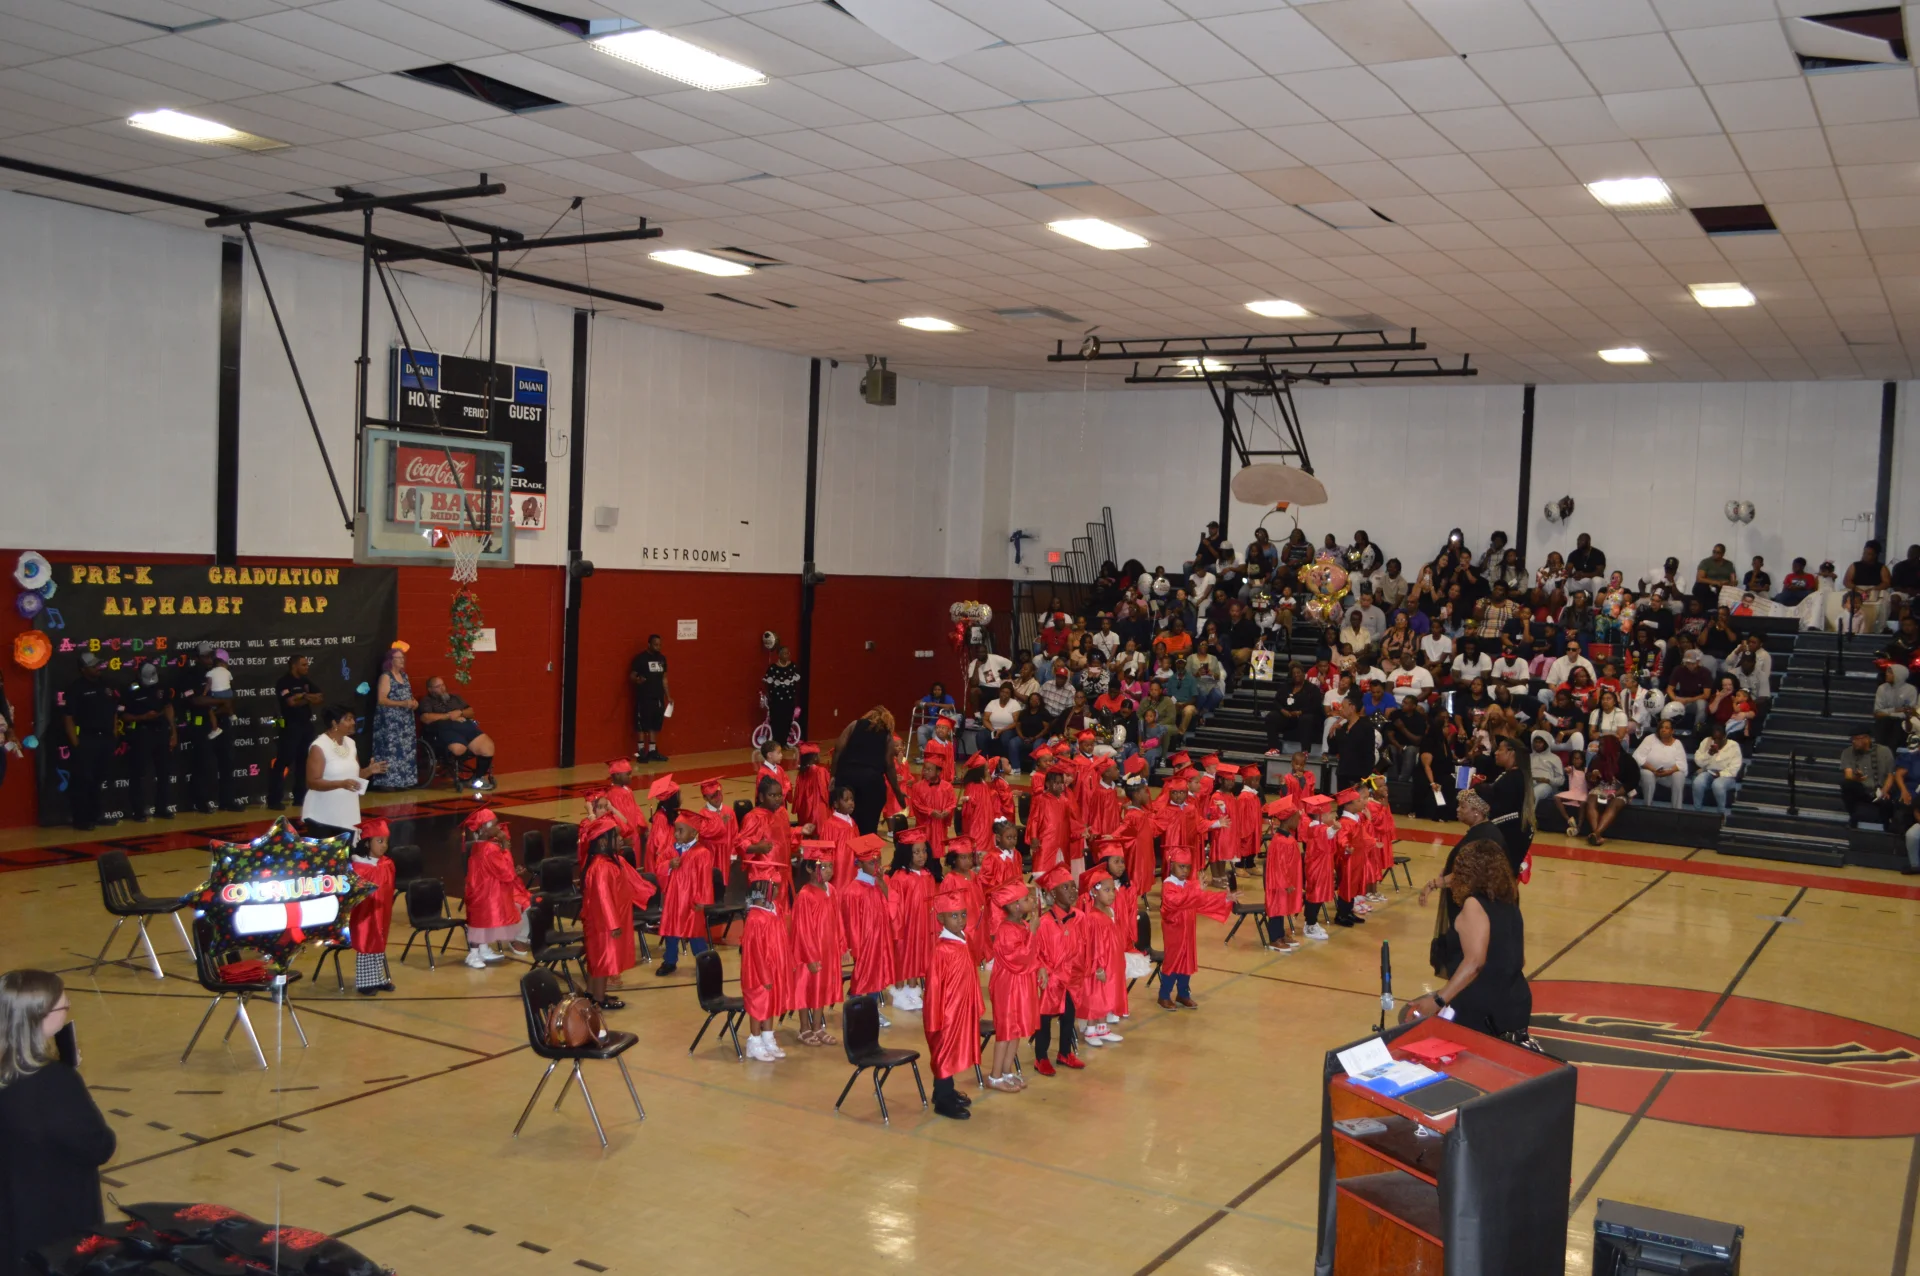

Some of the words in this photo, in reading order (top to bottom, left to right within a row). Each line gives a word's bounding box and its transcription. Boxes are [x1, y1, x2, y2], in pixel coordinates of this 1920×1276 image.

[518, 380, 544, 392] DASANI
[408, 391, 442, 409] HOME
[463, 406, 489, 419] PERIOD
[509, 404, 542, 422] GUEST
[406, 457, 468, 484] Coca-Cola
[431, 492, 515, 515] BAKER
[430, 511, 469, 521] MIDDE
[642, 547, 727, 562] RESTROOMS
[72, 564, 153, 585] PRE-K
[208, 566, 340, 586] GRADUATION
[103, 596, 244, 616] ALPHABET
[284, 596, 328, 614] RAP
[247, 639, 264, 648] WILL
[269, 639, 279, 647] BE
[282, 638, 296, 646] THE
[300, 637, 321, 646] PLACE
[342, 636, 356, 644] ME!
[234, 738, 254, 746] GOAL
[258, 736, 270, 744] TO
[104, 810, 124, 819] HAD
